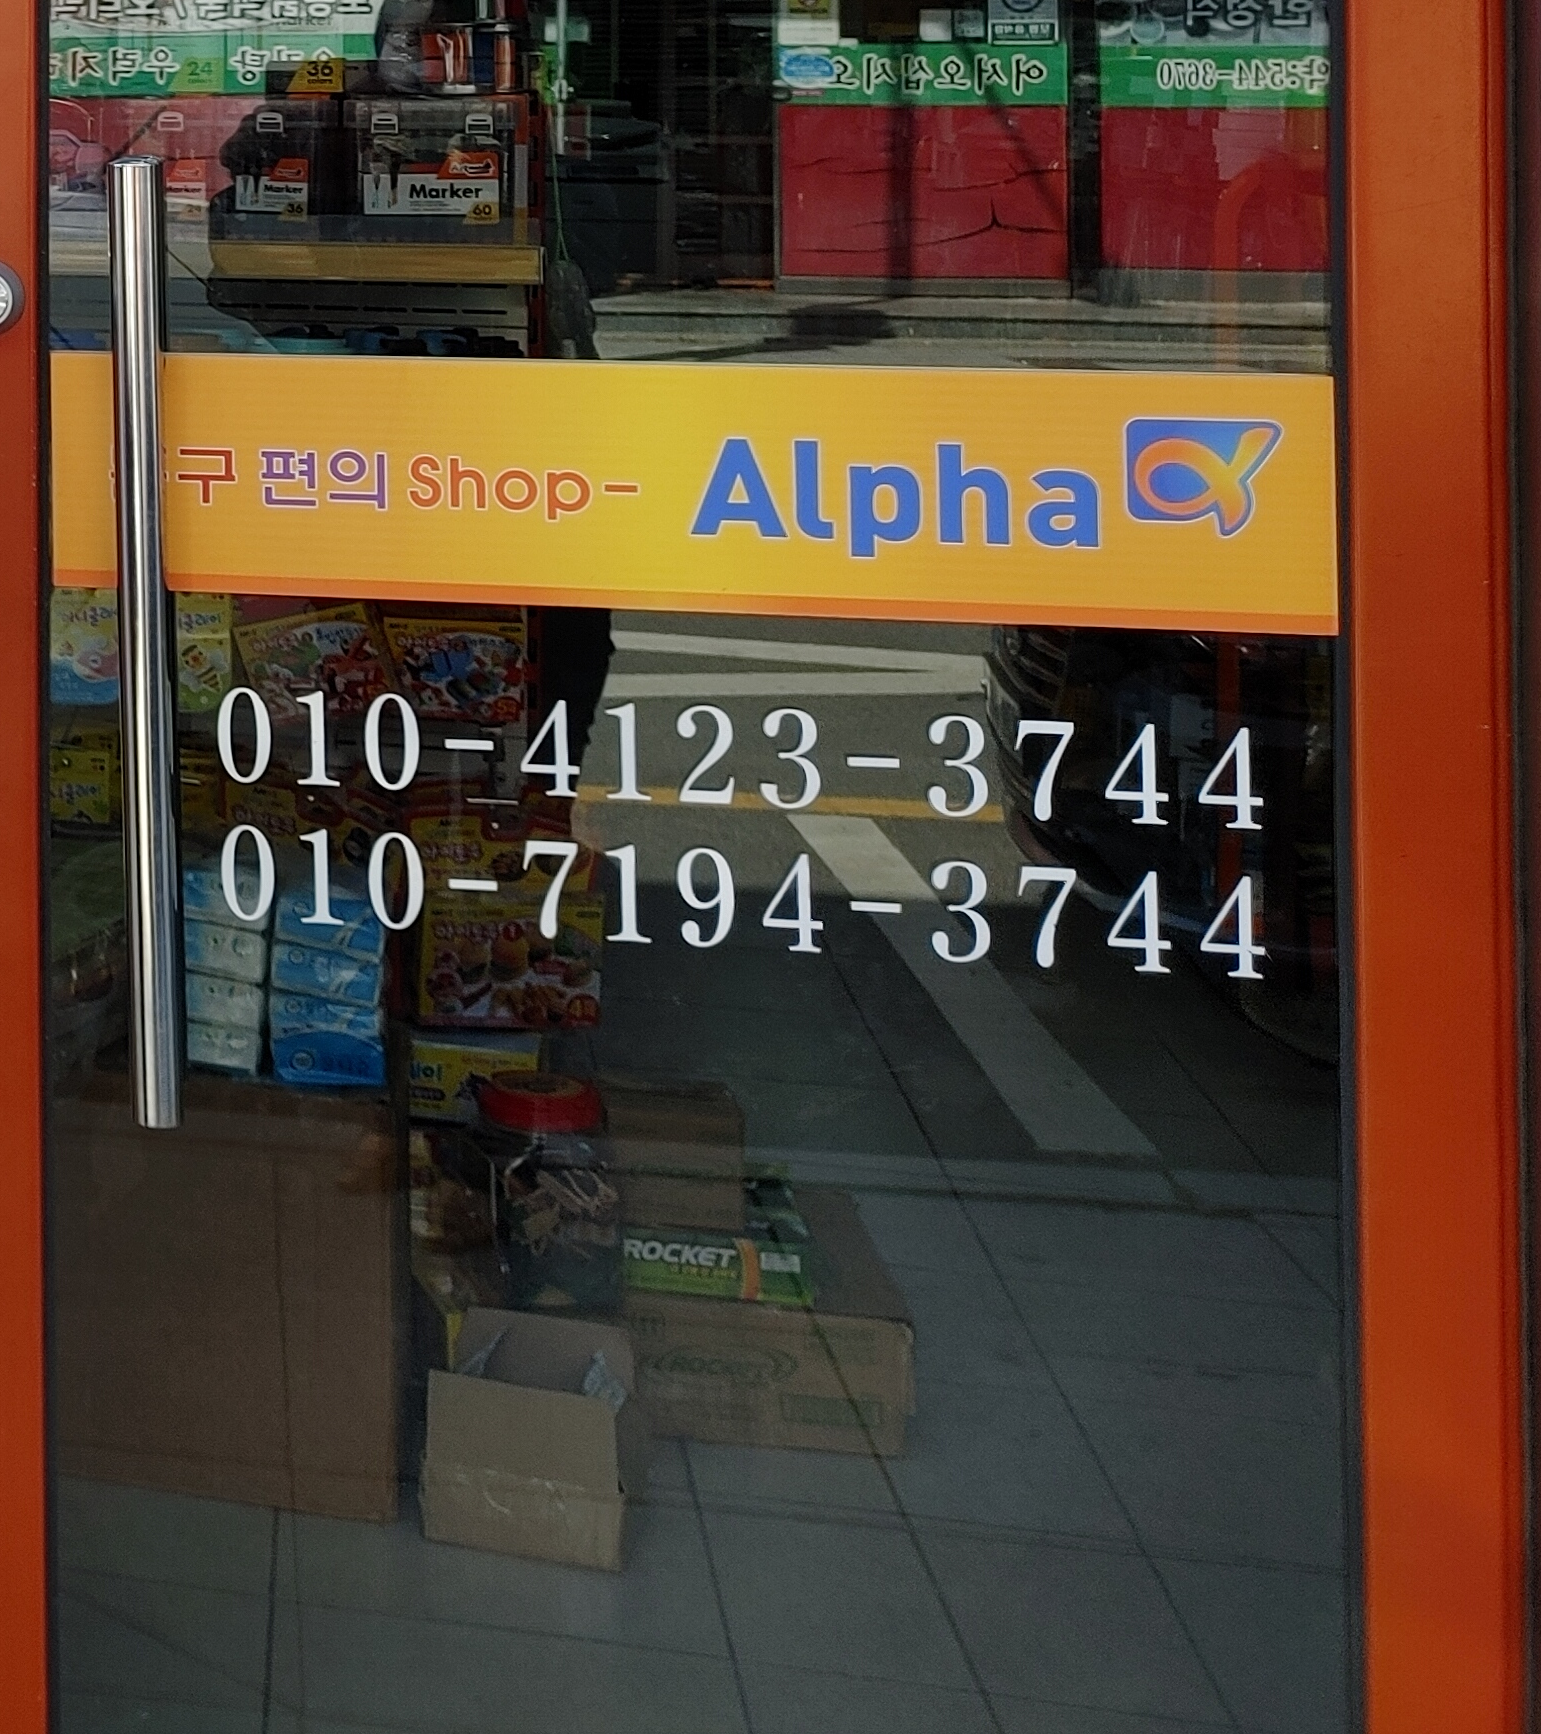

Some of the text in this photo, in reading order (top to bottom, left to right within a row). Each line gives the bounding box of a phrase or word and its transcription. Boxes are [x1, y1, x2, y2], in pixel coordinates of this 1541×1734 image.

[263, 183, 304, 196] Marker
[408, 181, 482, 201] Marker
[472, 202, 492, 216] 60
[258, 444, 389, 513] 편의
[691, 437, 1102, 558] Alpha
[216, 686, 1266, 831] 010-4123-3744
[219, 823, 1268, 981] 010-7194-3744
[623, 1237, 737, 1268] ROCKET
